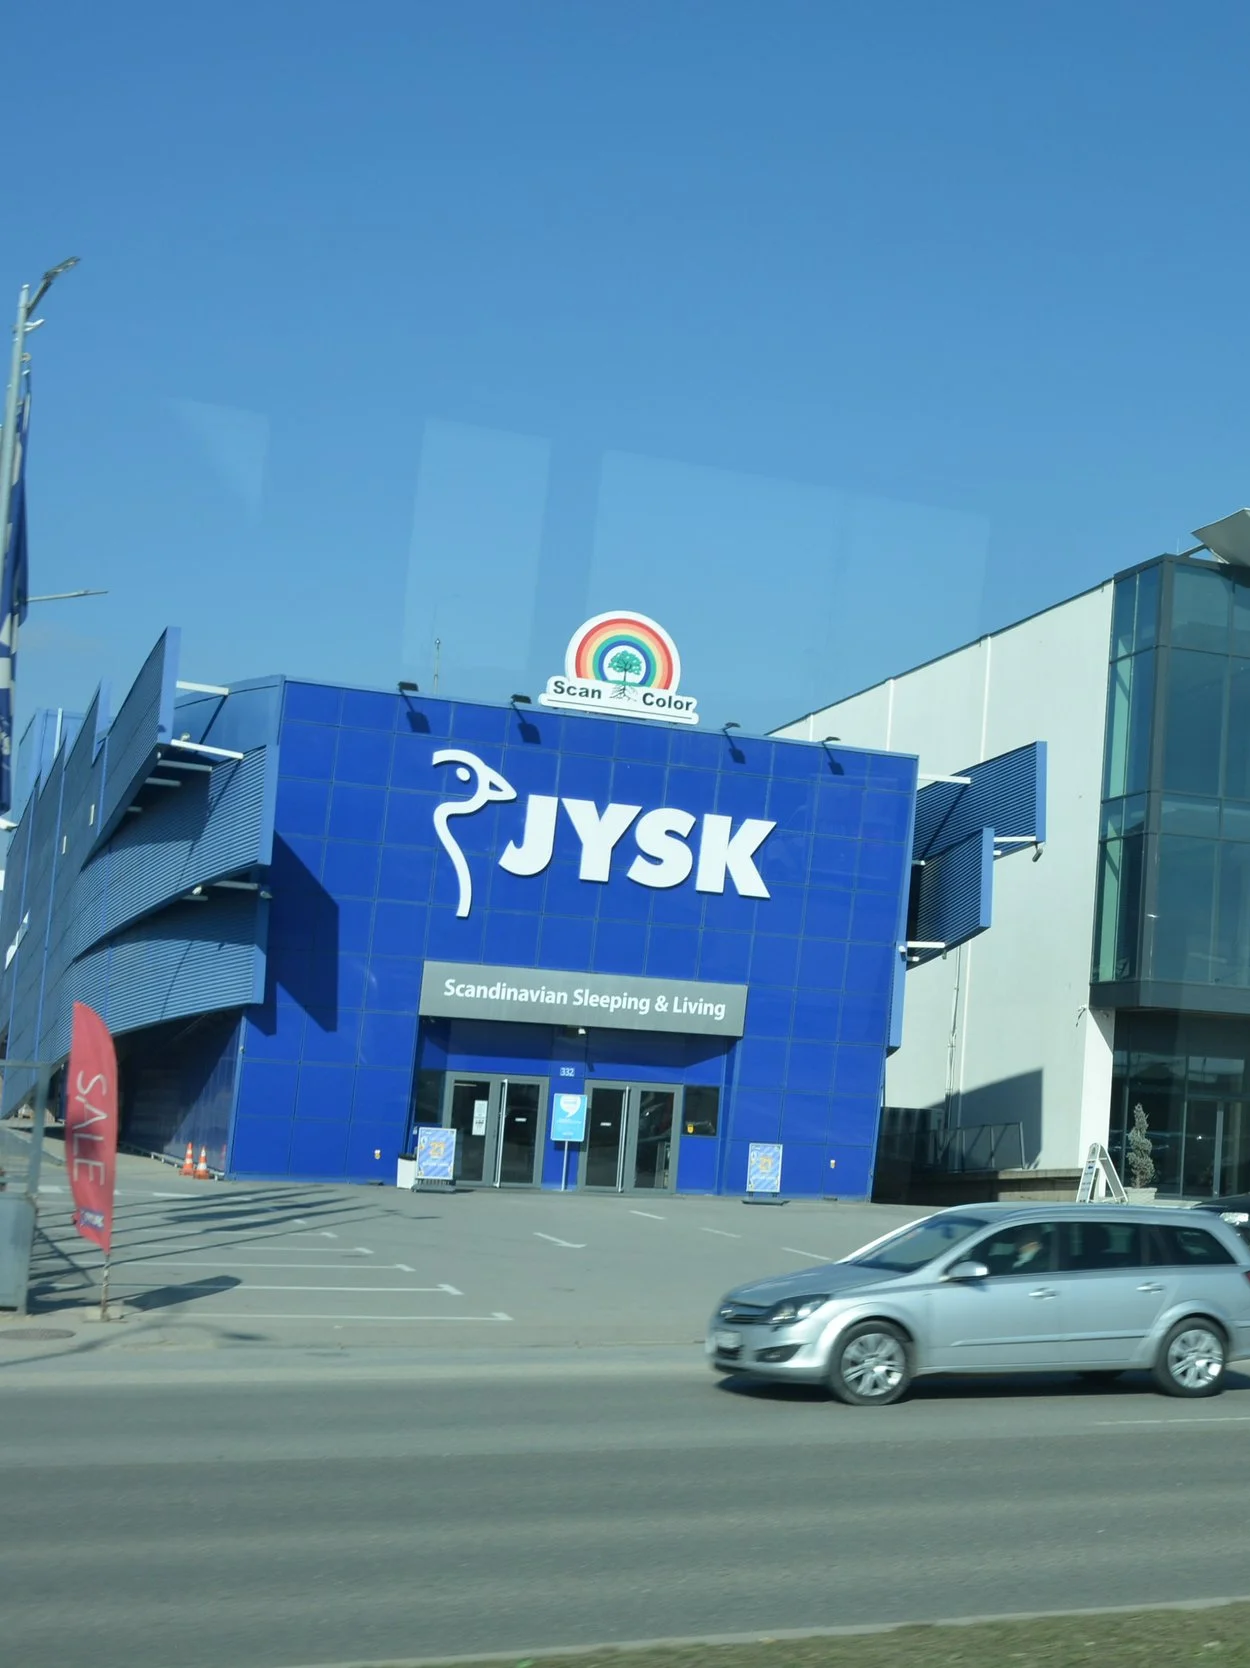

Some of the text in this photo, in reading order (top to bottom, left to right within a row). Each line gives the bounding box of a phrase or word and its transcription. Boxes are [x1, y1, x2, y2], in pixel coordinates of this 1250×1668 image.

[552, 680, 693, 711] Scan Color
[498, 794, 778, 899] JYSK
[443, 978, 726, 1021] Scandinavian Sleeping & Living
[559, 1067, 575, 1077] 332
[72, 1070, 108, 1186] SALE
